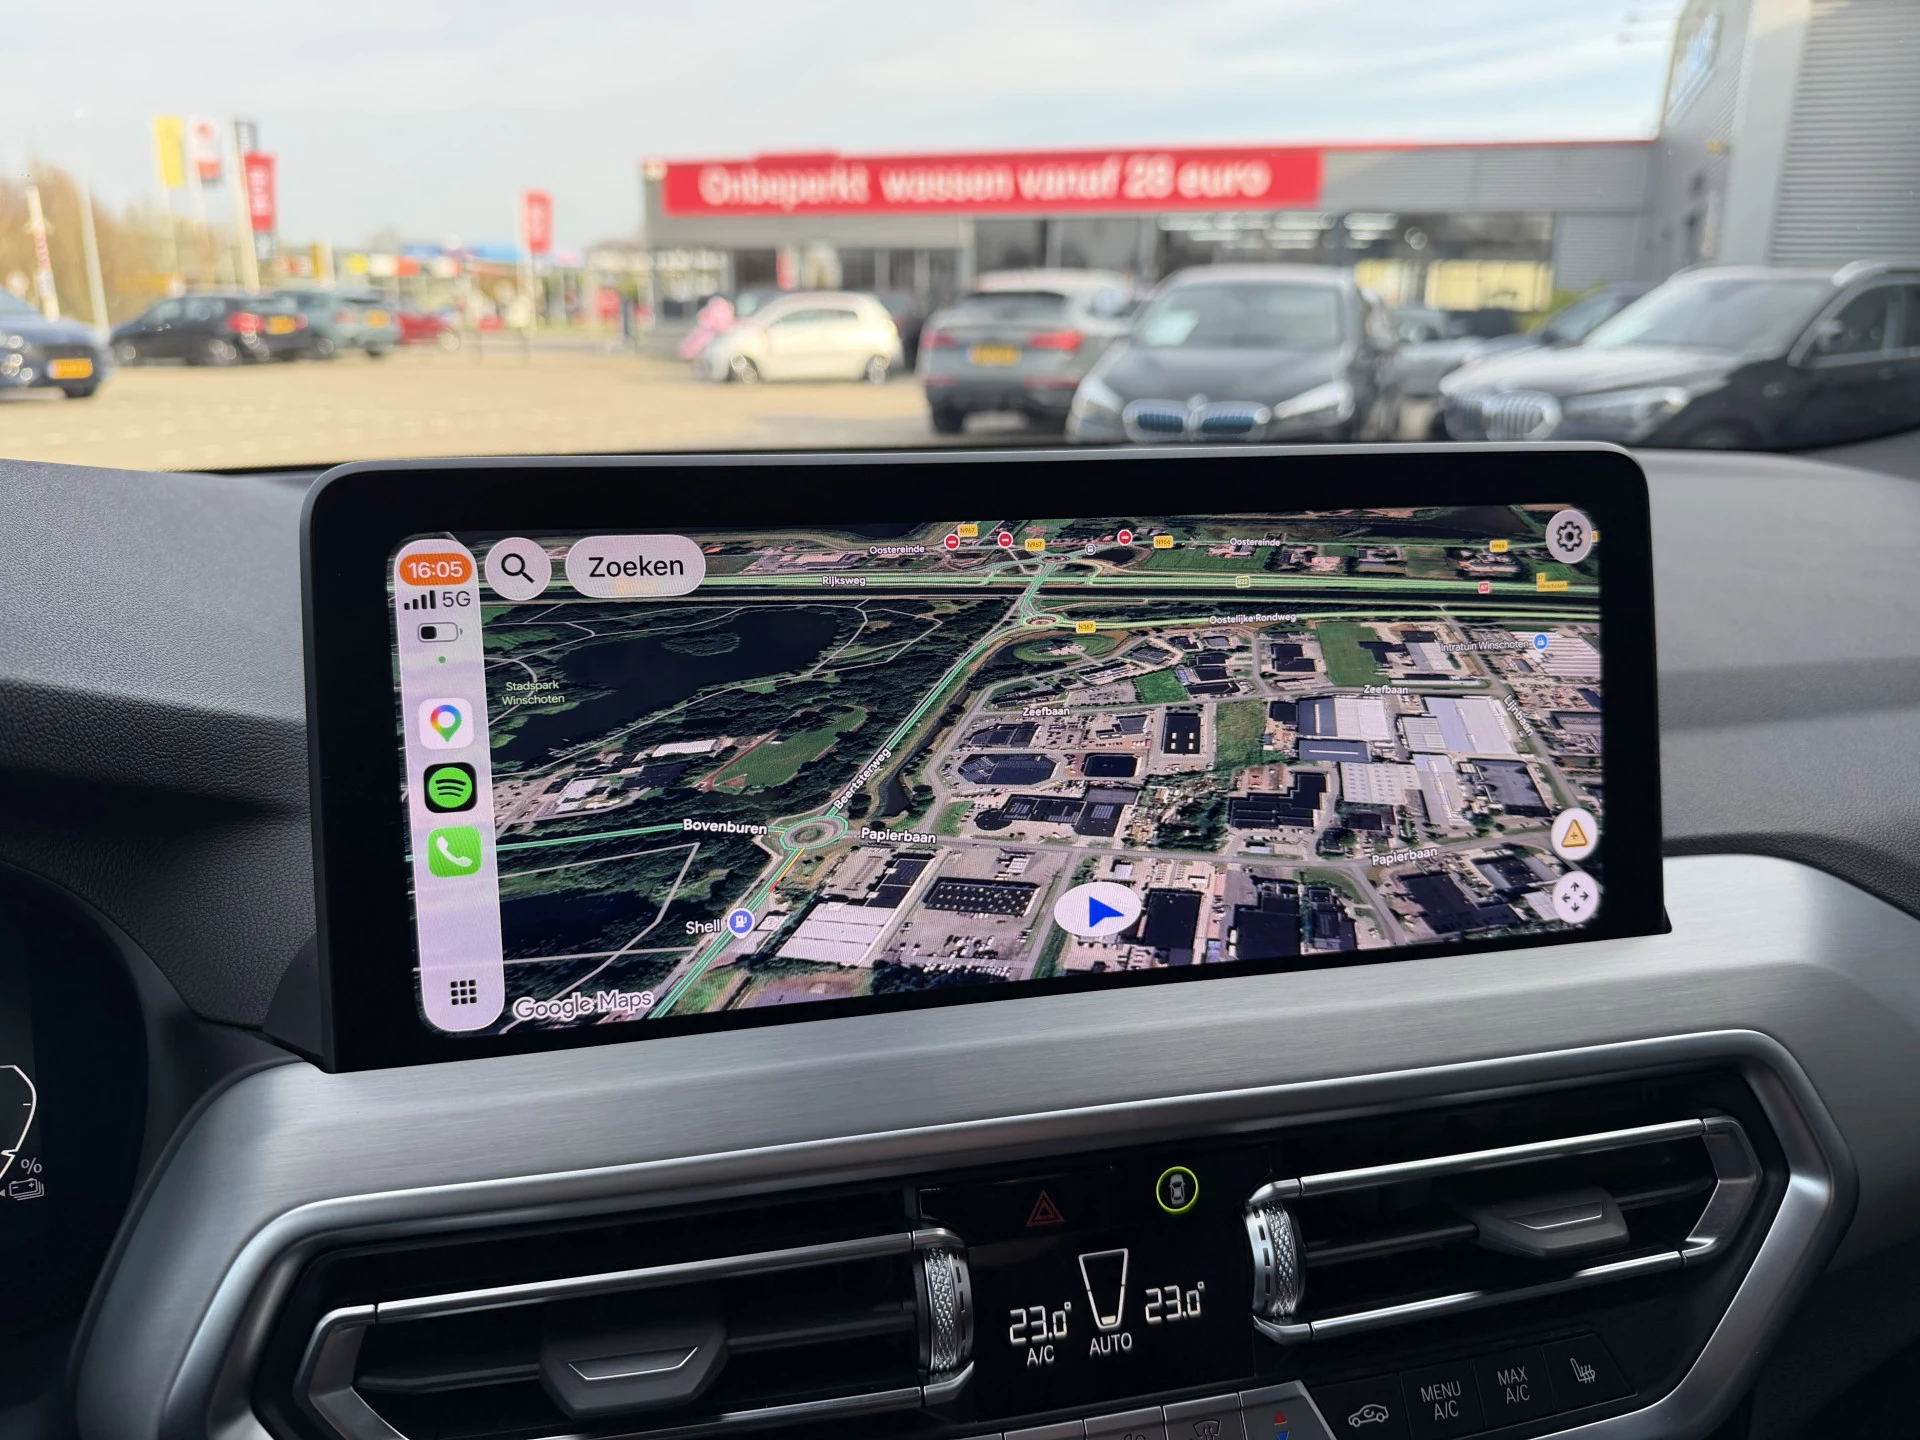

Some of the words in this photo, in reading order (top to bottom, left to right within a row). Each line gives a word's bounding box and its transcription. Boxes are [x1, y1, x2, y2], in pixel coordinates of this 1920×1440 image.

[700, 162, 869, 211] Onbeperkt
[880, 163, 1015, 204] wassen
[1018, 155, 1121, 202] vanaf
[1124, 153, 1175, 199] 28
[1177, 160, 1272, 200] euro
[869, 544, 925, 555] Oostereinde
[1230, 537, 1281, 547] Oostereinde
[407, 561, 463, 579] 16:05
[588, 555, 684, 577] Zoeken
[821, 575, 866, 587] Rijksweg
[1237, 578, 1249, 586] E22
[442, 590, 471, 608] 5G
[1209, 615, 1254, 625] Oostelijke
[1255, 613, 1296, 624] Rondweg
[1440, 641, 1477, 652] Intratuin
[1479, 639, 1529, 650] Winschoten
[505, 680, 560, 693] Stadspark
[1363, 684, 1409, 694] Zeefbaan
[501, 694, 565, 705] Winschoten
[1022, 706, 1070, 717] Zeefbaan
[1503, 695, 1534, 737] Lijnbaan
[833, 748, 892, 810] Beertsterweg
[683, 819, 768, 835] Bovenburen
[860, 827, 937, 844] Papierbaan
[1372, 847, 1438, 866] Papierbaan
[685, 918, 721, 935] Shell
[514, 996, 593, 1021] Google
[600, 990, 654, 1014] Maps
[20, 1157, 43, 1175] %
[1089, 1332, 1133, 1356] AUTO
[1026, 1345, 1055, 1367] A/C
[1496, 1366, 1529, 1387] MAX
[1420, 1380, 1462, 1403] MENU
[1505, 1384, 1530, 1405] A/C
[1433, 1400, 1459, 1421] A/C
